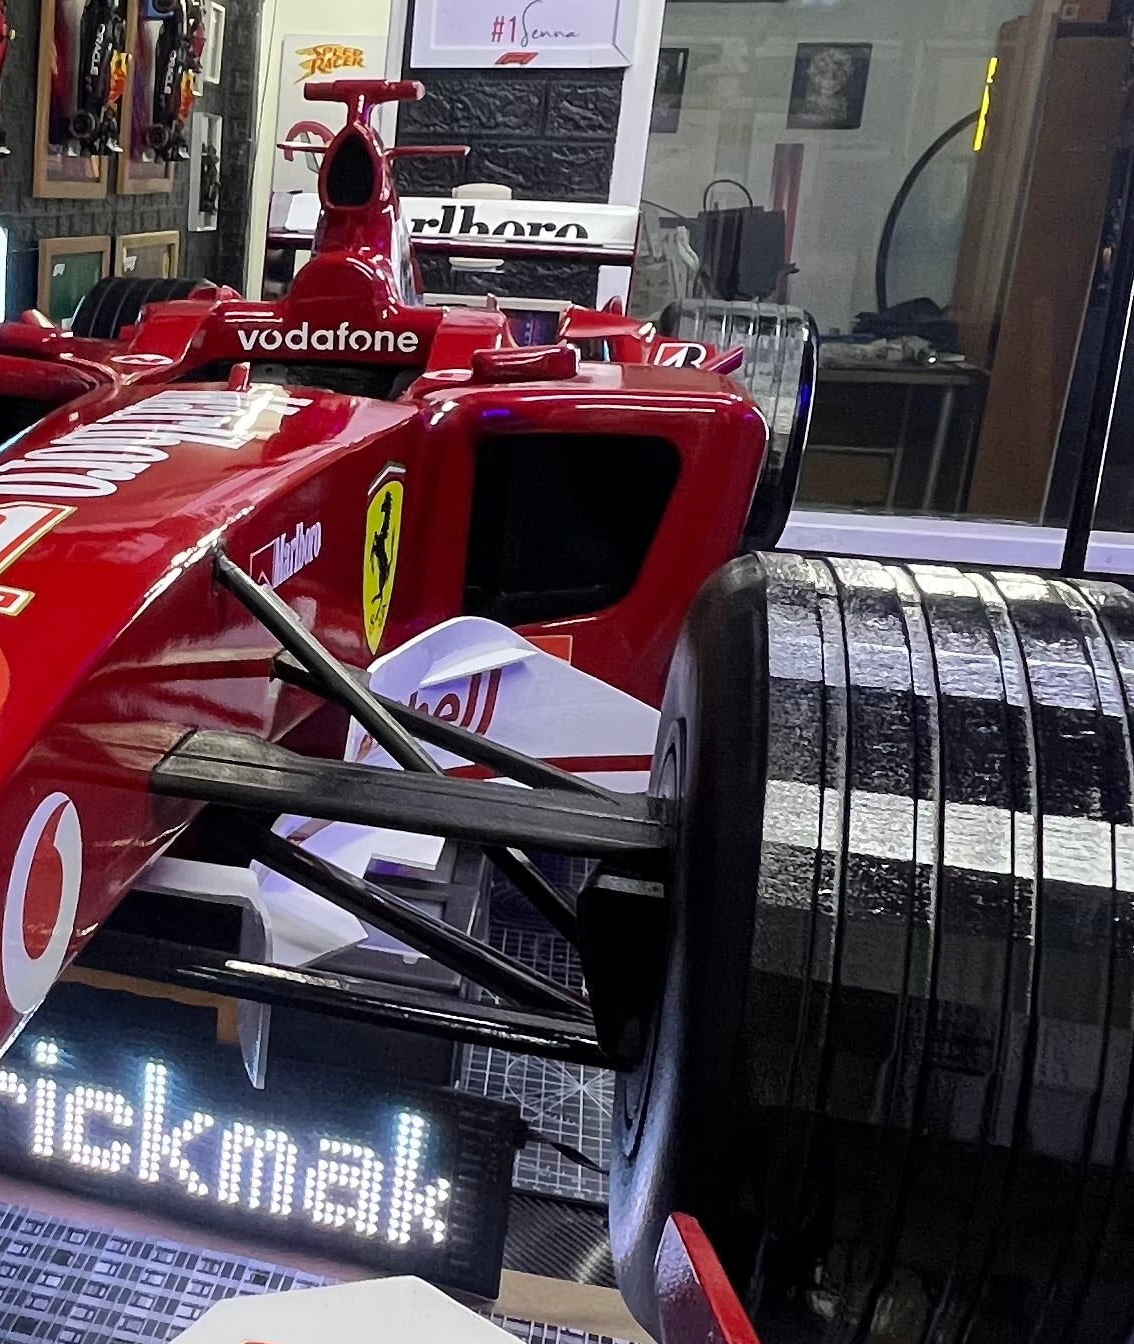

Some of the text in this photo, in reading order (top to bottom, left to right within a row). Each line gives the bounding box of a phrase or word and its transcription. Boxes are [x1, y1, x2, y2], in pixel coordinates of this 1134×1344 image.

[490, 0, 581, 49] #1 Senna
[90, 24, 106, 76] ORACLE
[310, 56, 366, 75] RACER
[237, 320, 420, 355] vodafone
